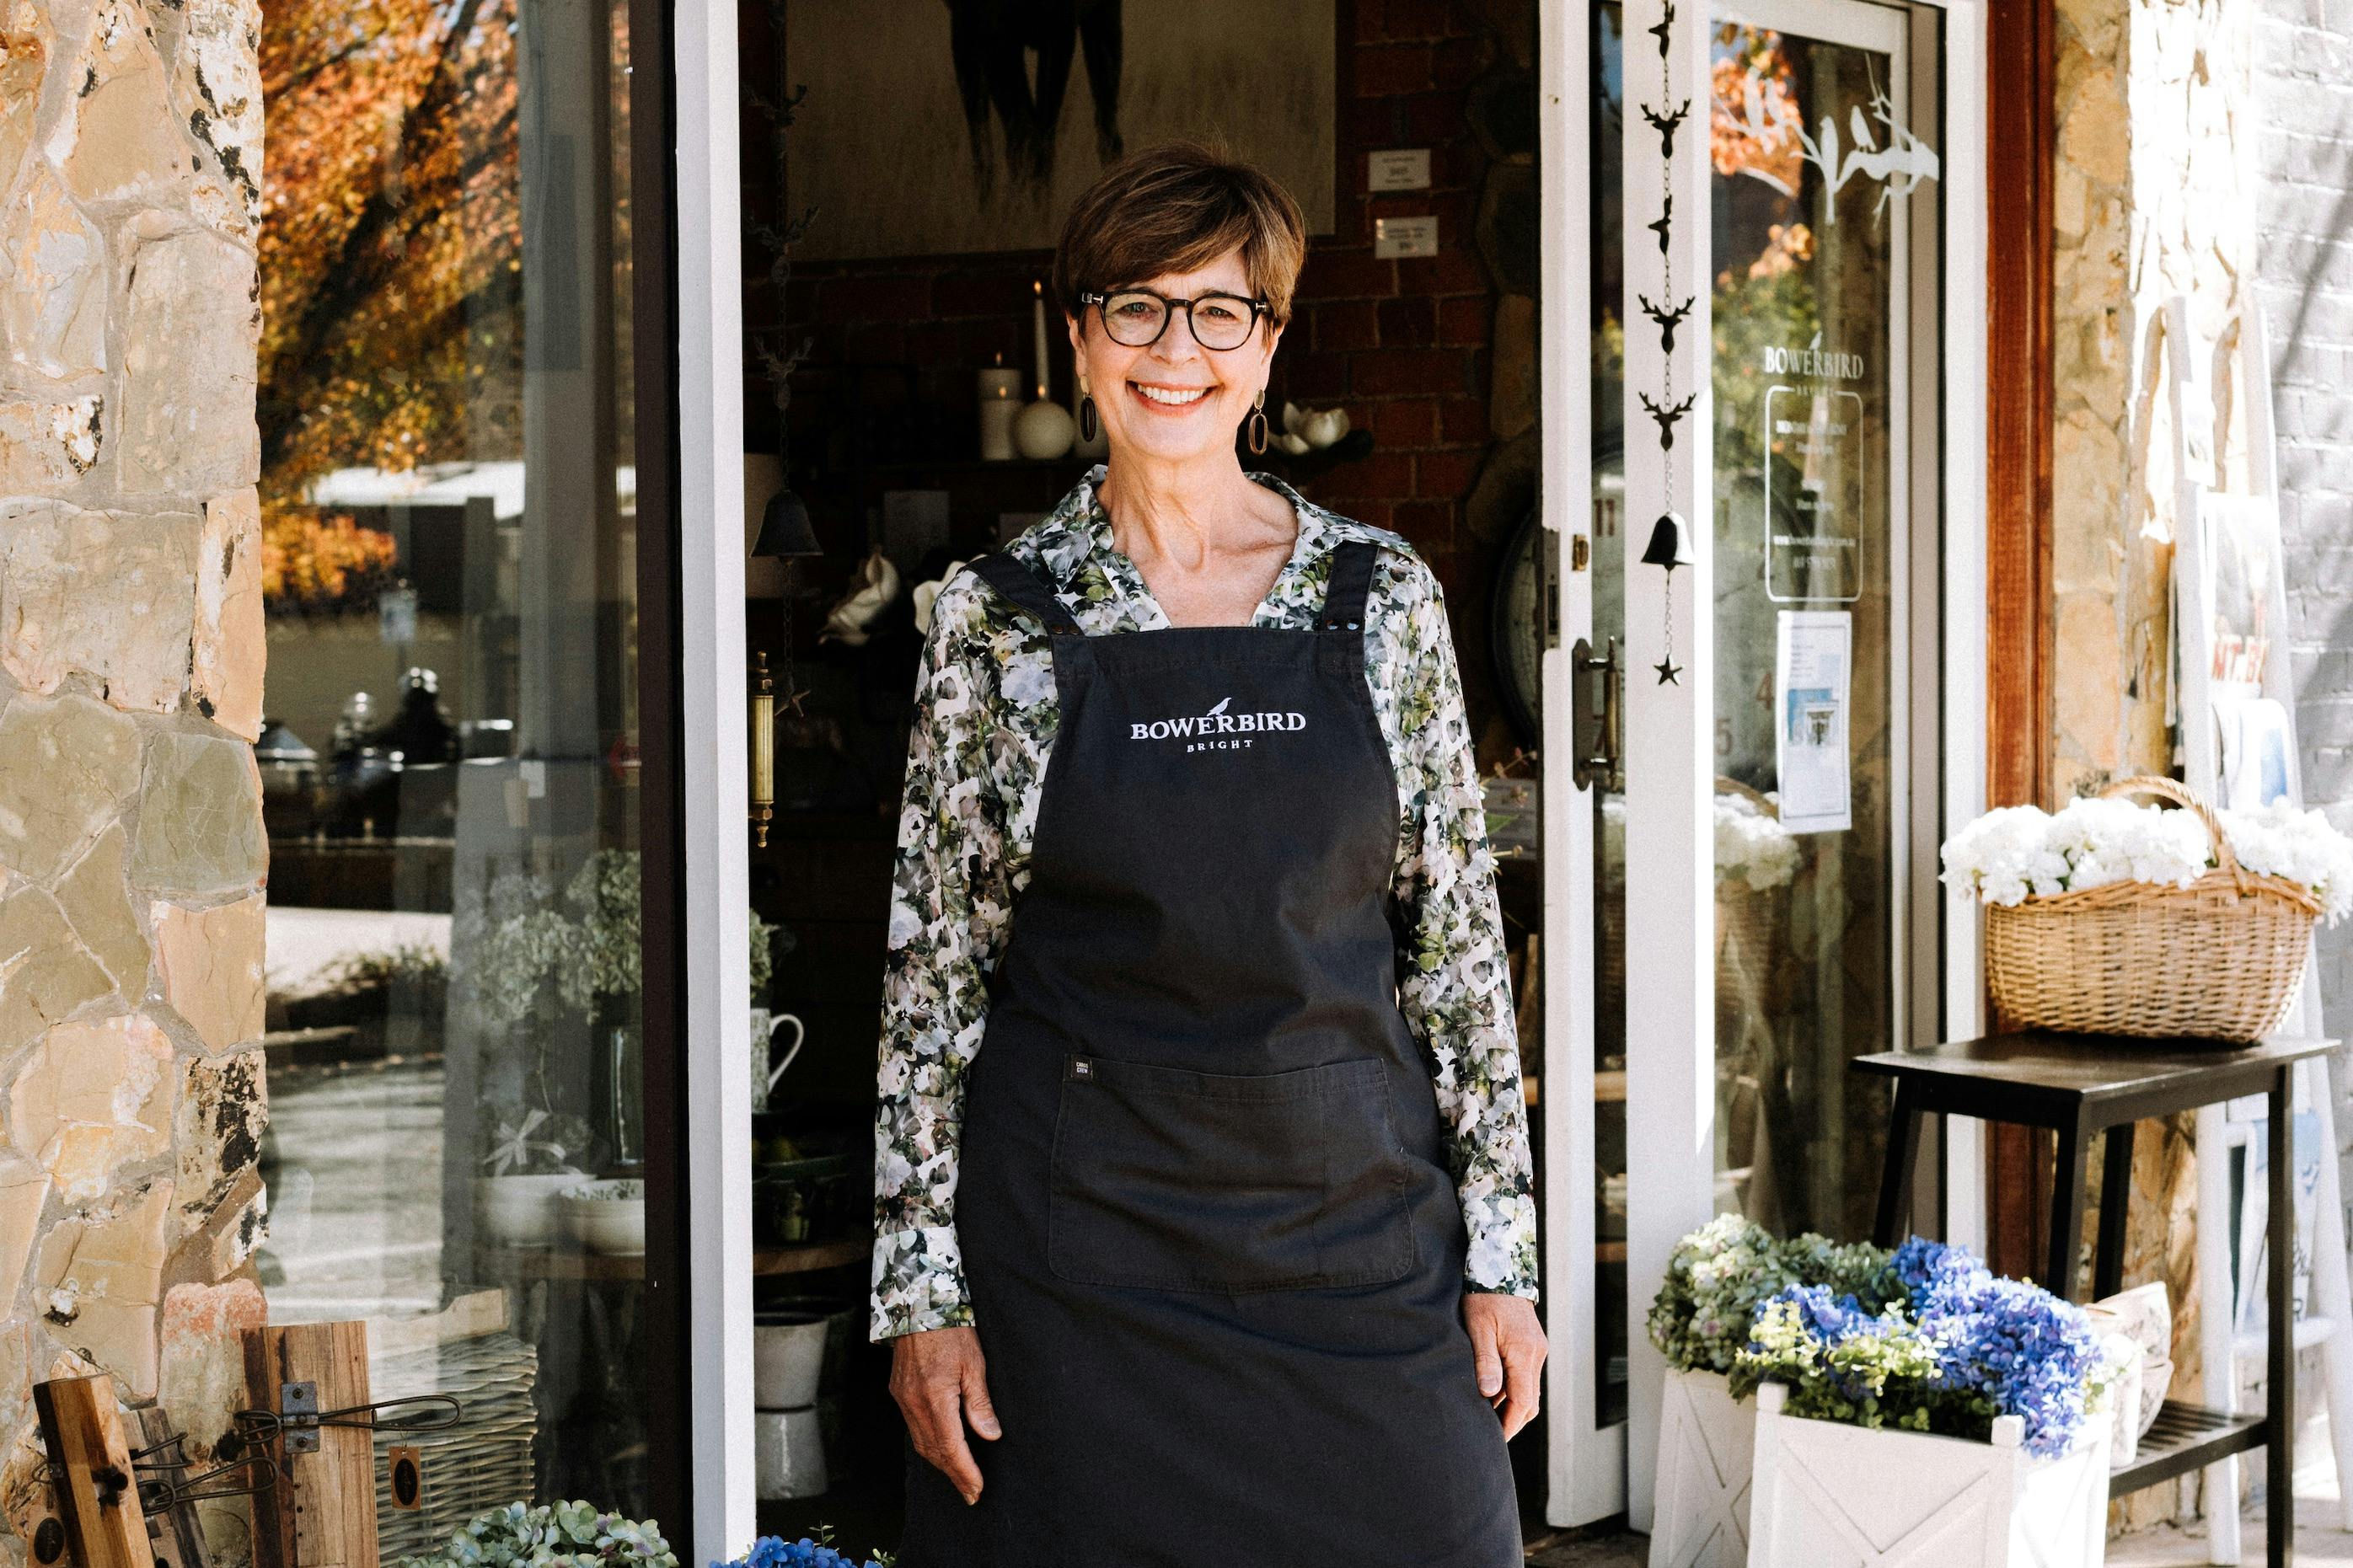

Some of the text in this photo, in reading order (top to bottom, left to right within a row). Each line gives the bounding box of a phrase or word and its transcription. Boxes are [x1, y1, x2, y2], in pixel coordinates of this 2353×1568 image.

[1764, 345, 1864, 379] BOWERBIRD
[1756, 672, 1775, 710] 4
[1130, 712, 1307, 740] BOWERBIRD
[1187, 739, 1253, 752] BRIGHT
